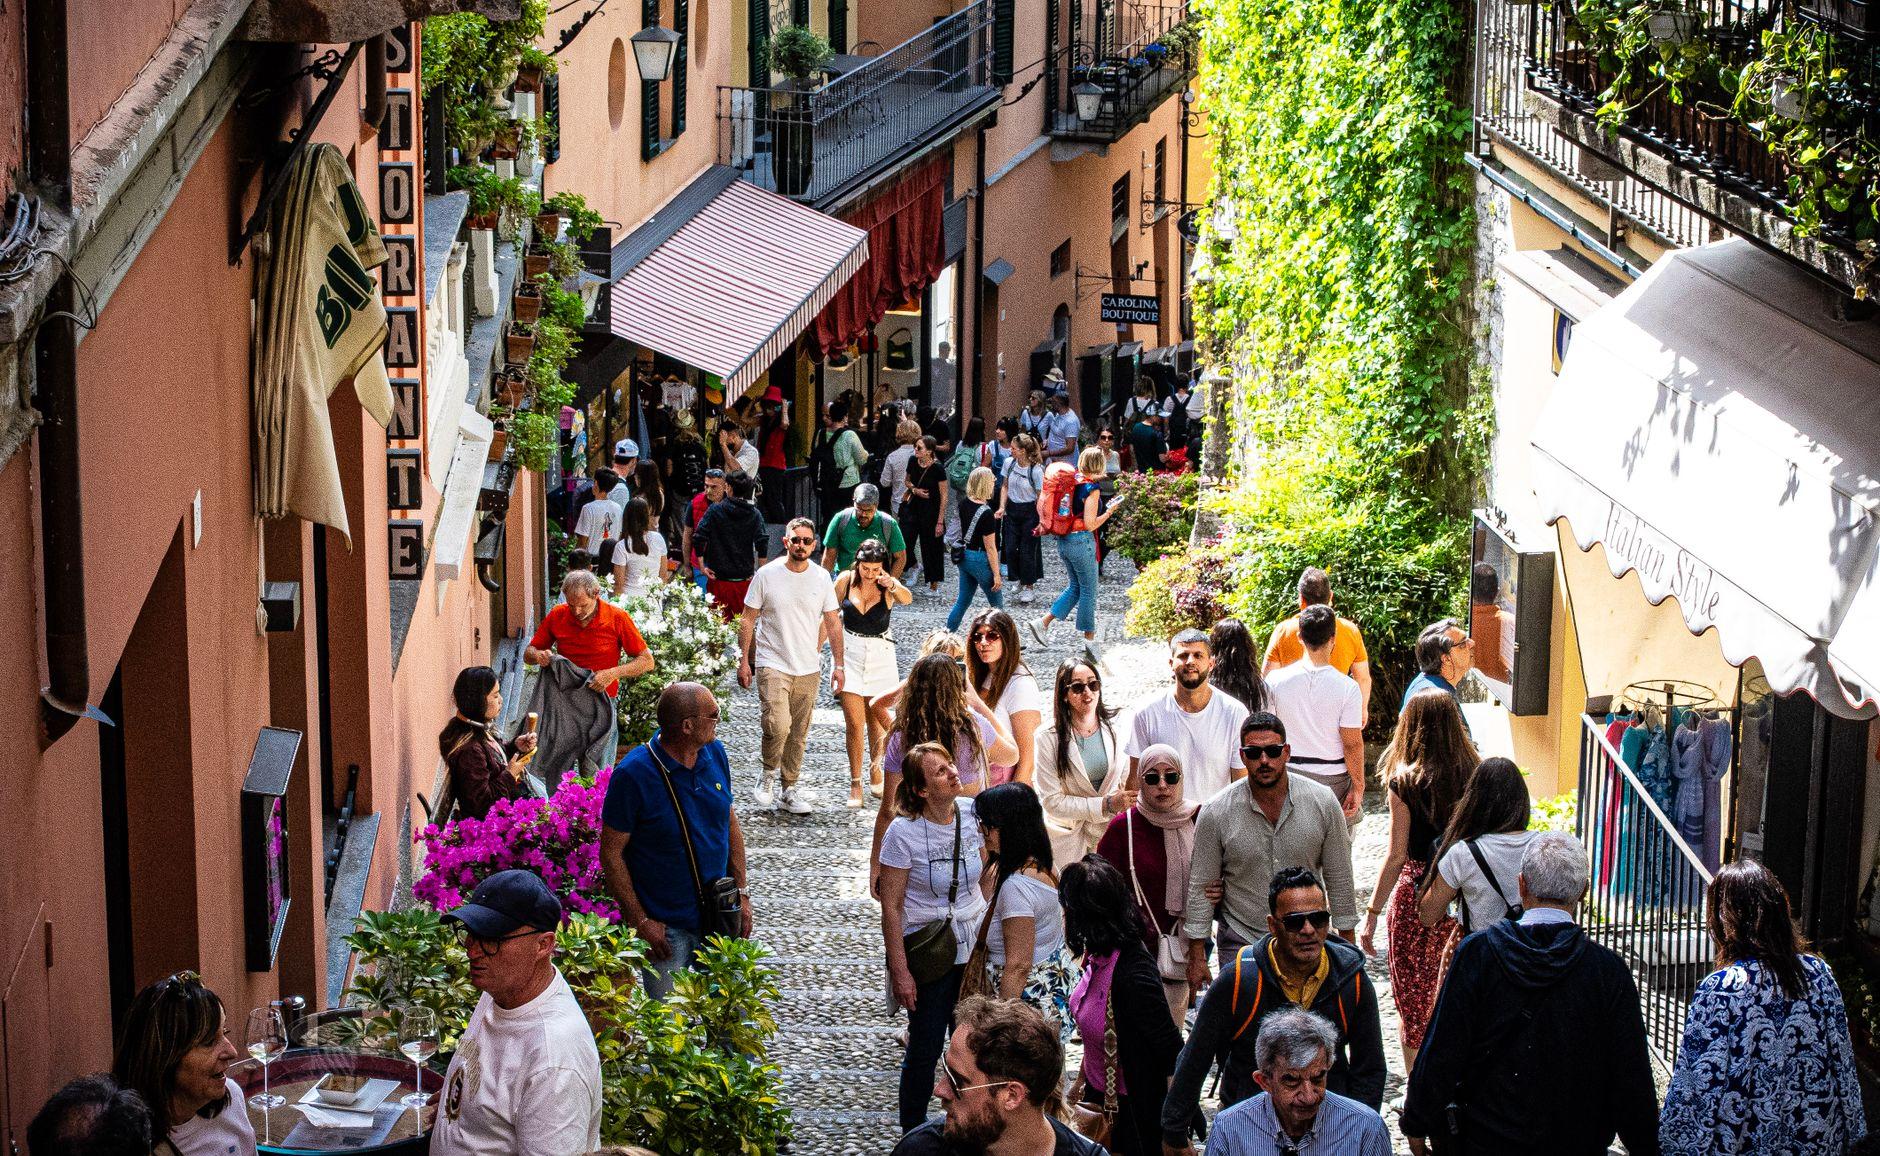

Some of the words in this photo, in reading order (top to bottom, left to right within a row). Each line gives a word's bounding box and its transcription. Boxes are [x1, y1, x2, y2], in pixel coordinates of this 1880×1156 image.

[1101, 297, 1158, 309] CAROLINA
[1102, 309, 1158, 322] BOUTIQUE
[1604, 501, 1665, 583] Italian
[1670, 549, 1719, 623] Style
